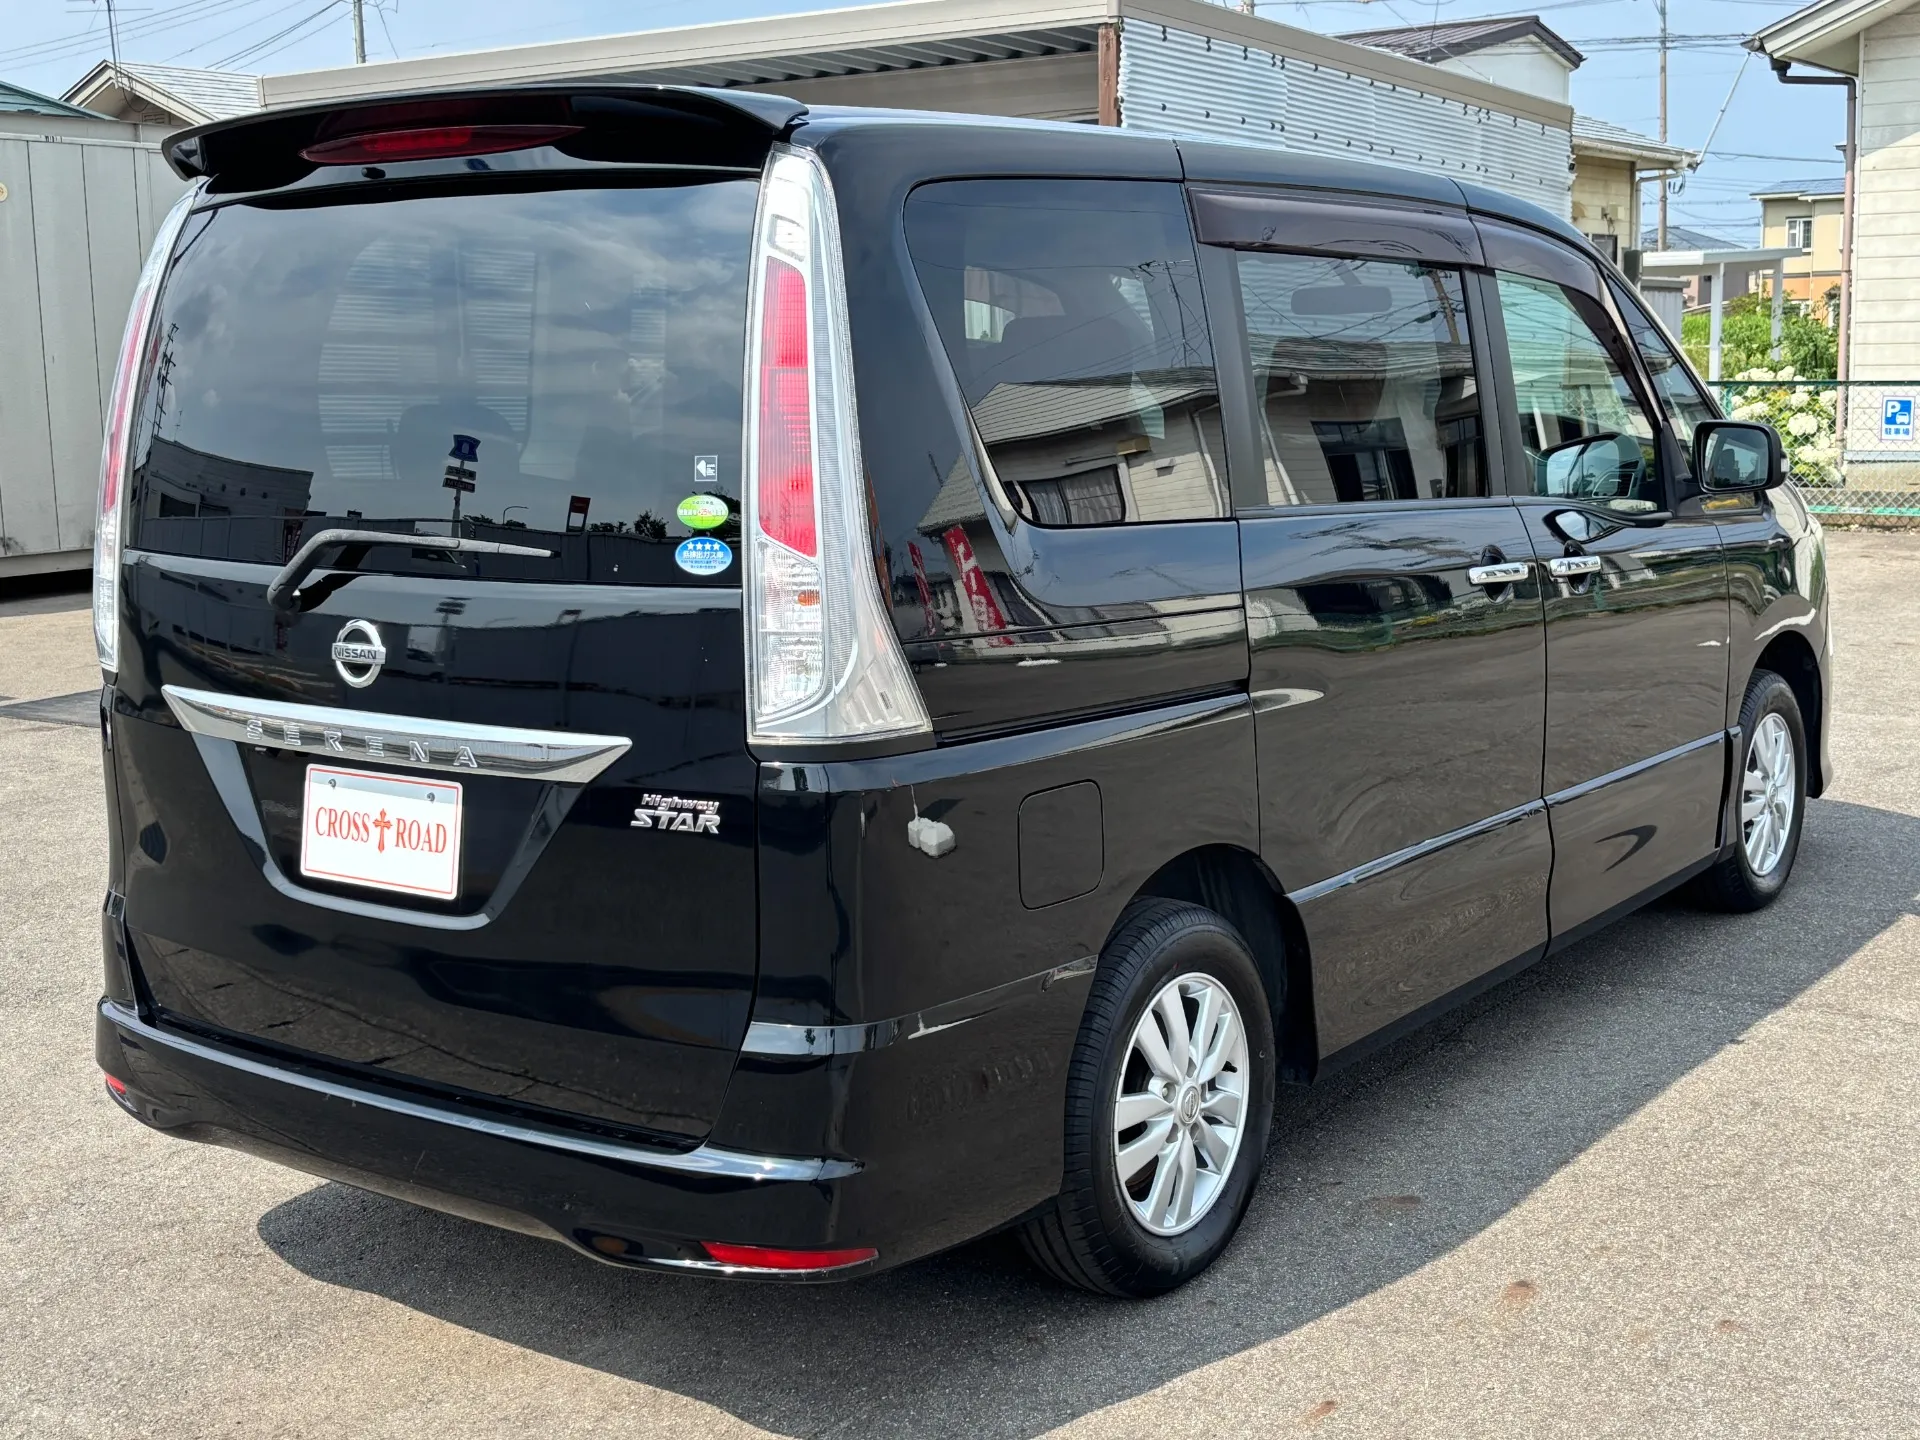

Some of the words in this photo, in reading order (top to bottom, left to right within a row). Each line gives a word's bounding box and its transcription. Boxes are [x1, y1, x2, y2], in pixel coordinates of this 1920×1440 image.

[1886, 401, 1901, 417] P
[333, 646, 378, 661] NISSAN
[246, 718, 478, 769] SERENA
[641, 793, 720, 815] Highway
[315, 806, 371, 843] CROSS
[395, 817, 447, 854] ROAD
[630, 808, 721, 834] STAR
